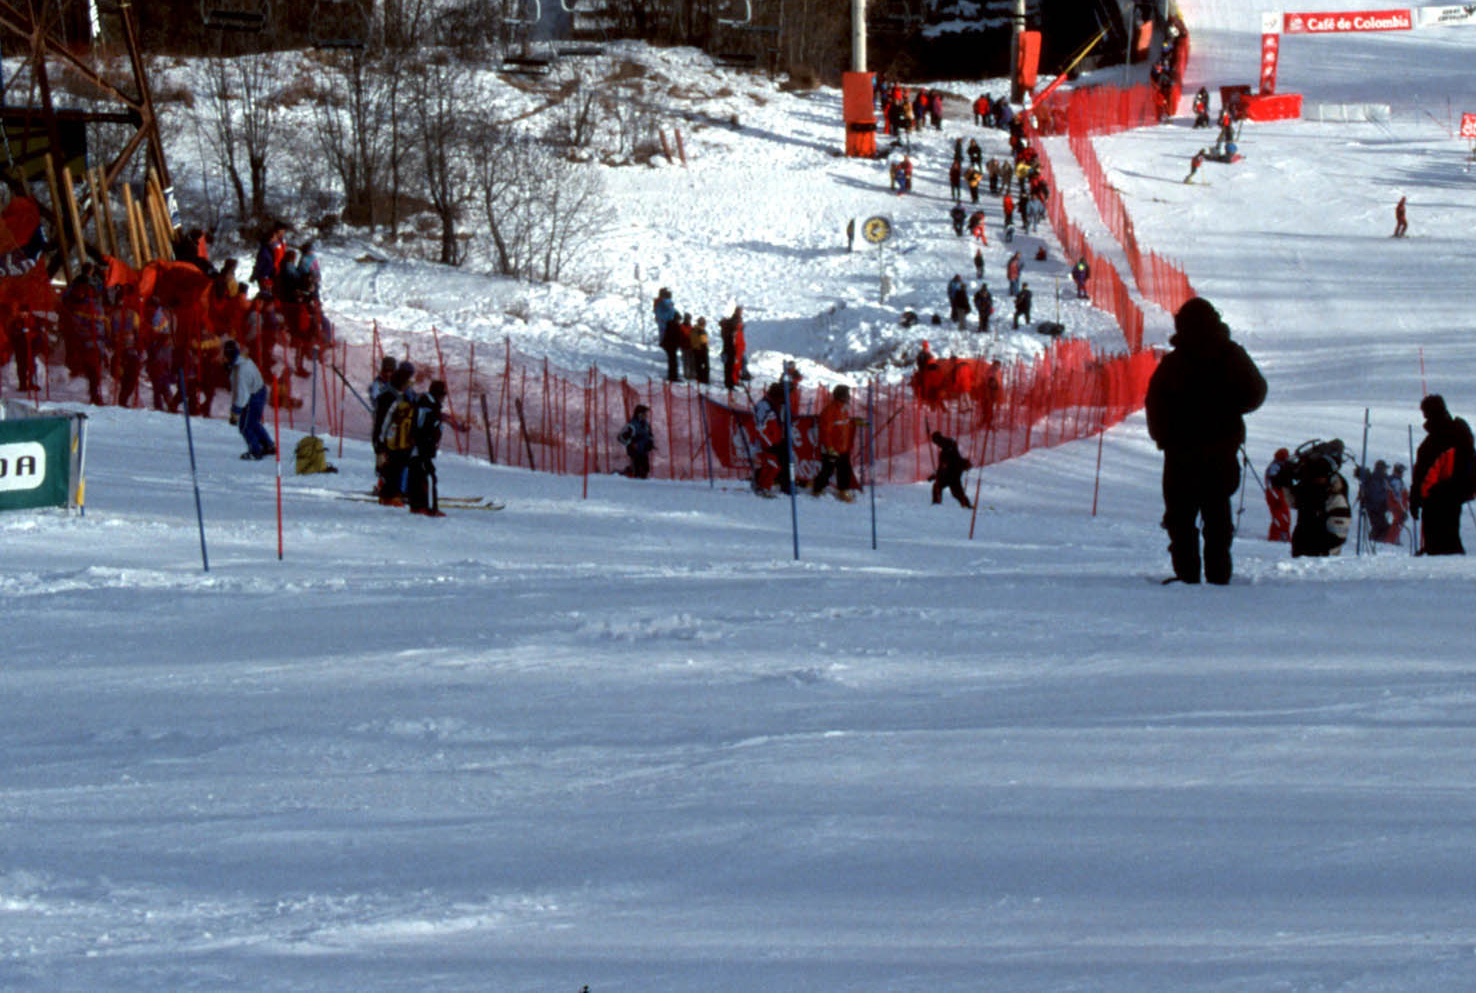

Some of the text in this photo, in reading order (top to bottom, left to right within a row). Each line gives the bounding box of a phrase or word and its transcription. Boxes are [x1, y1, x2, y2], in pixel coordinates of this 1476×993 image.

[1307, 15, 1409, 30] Café de Colombia
